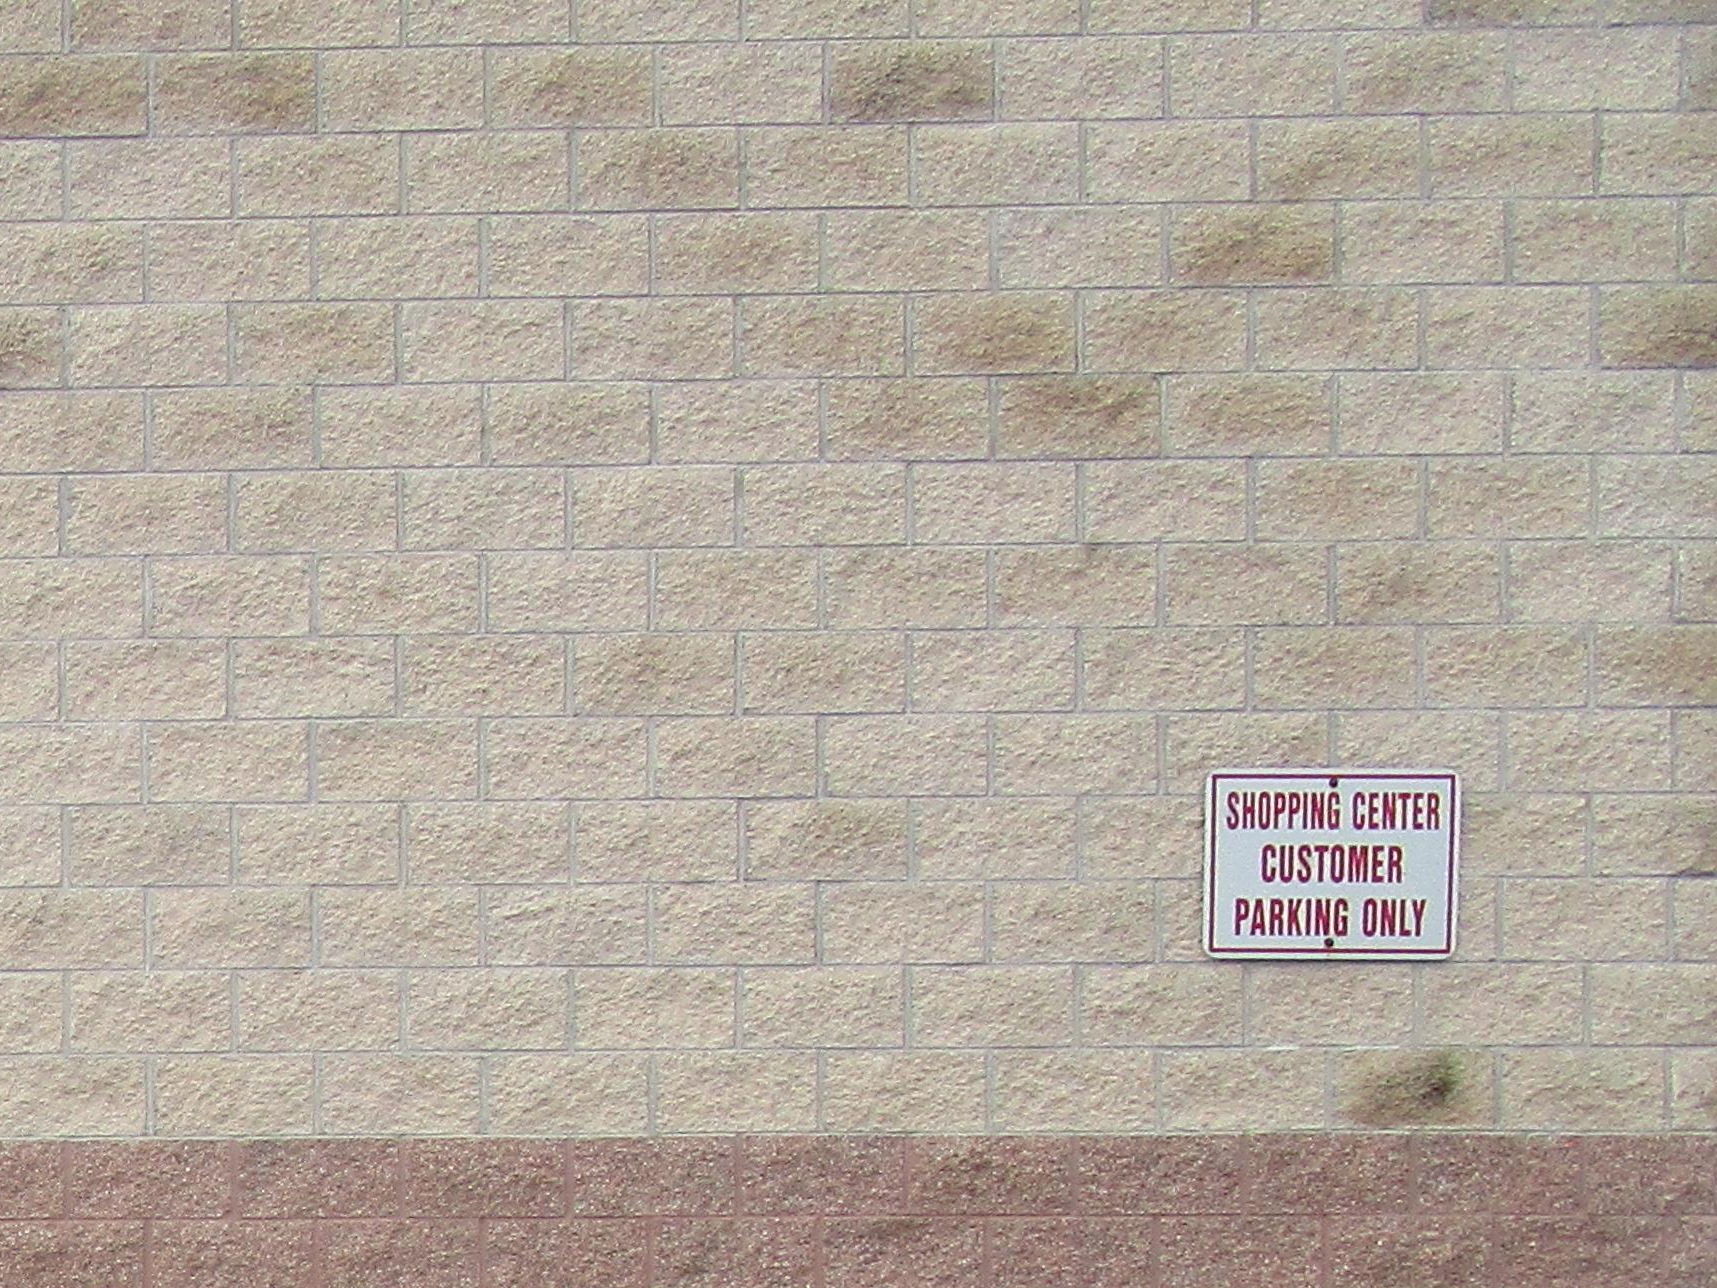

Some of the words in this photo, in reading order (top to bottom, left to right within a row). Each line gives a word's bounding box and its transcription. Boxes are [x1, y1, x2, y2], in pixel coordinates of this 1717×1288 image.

[1226, 791, 1341, 831] SHOPPING
[1352, 791, 1441, 831] CENTER
[1261, 844, 1404, 884] CUSTOMER
[1234, 898, 1349, 937] PARKING
[1362, 898, 1428, 937] ONLY
